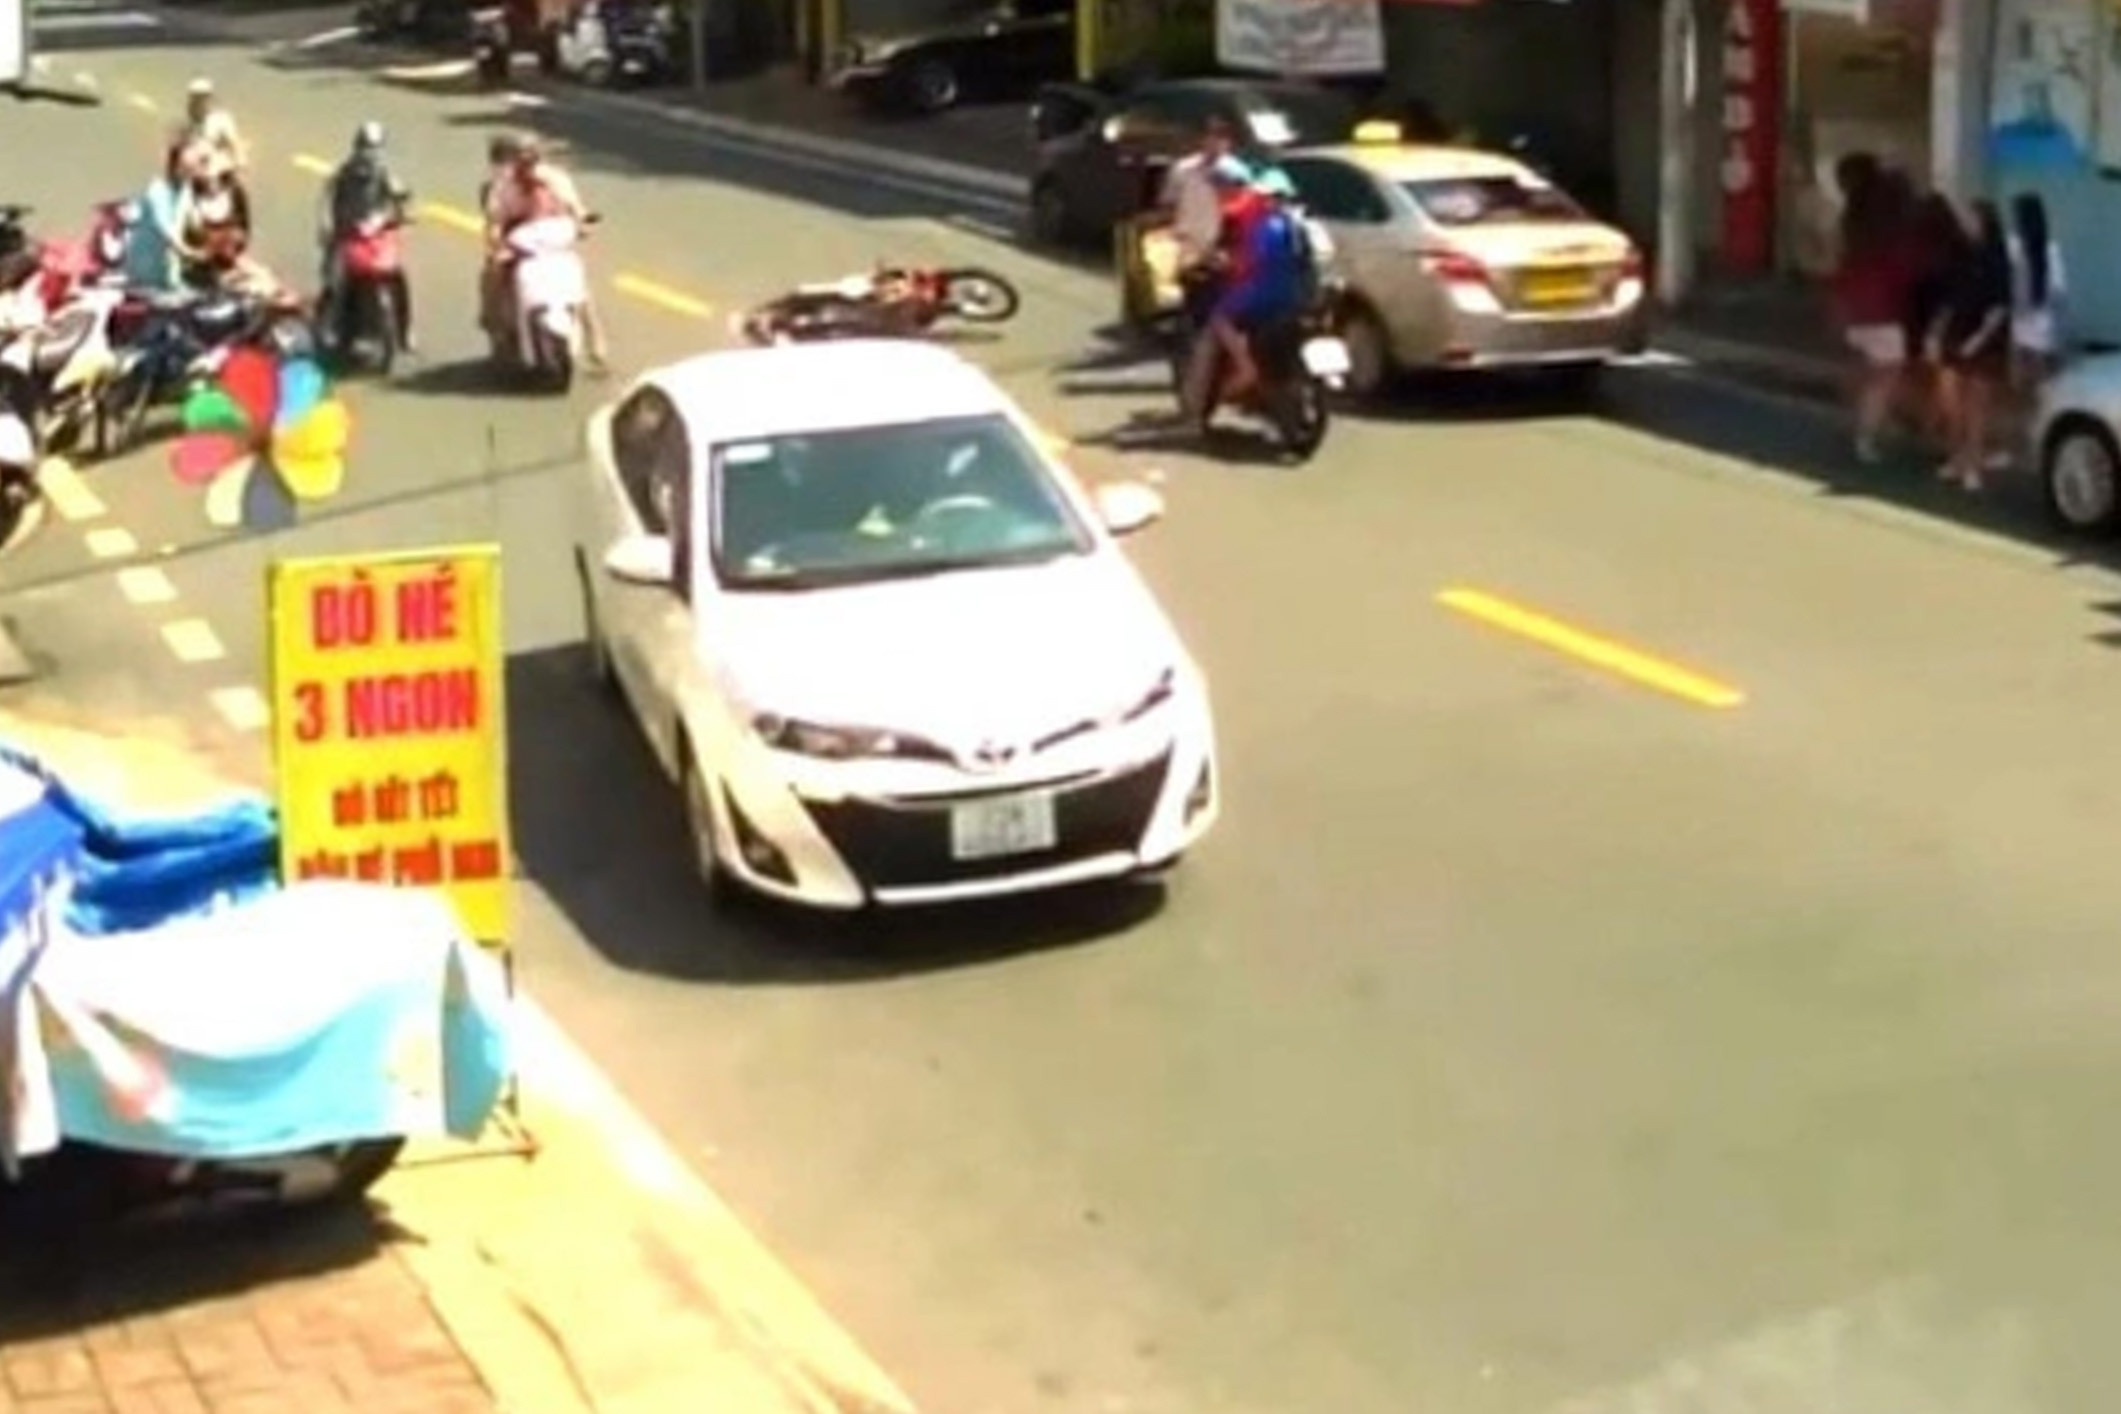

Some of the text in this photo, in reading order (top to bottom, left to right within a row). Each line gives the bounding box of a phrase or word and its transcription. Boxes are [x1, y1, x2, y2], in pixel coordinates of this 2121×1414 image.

[397, 562, 458, 643] NÉ
[294, 669, 479, 742] 3 NGON
